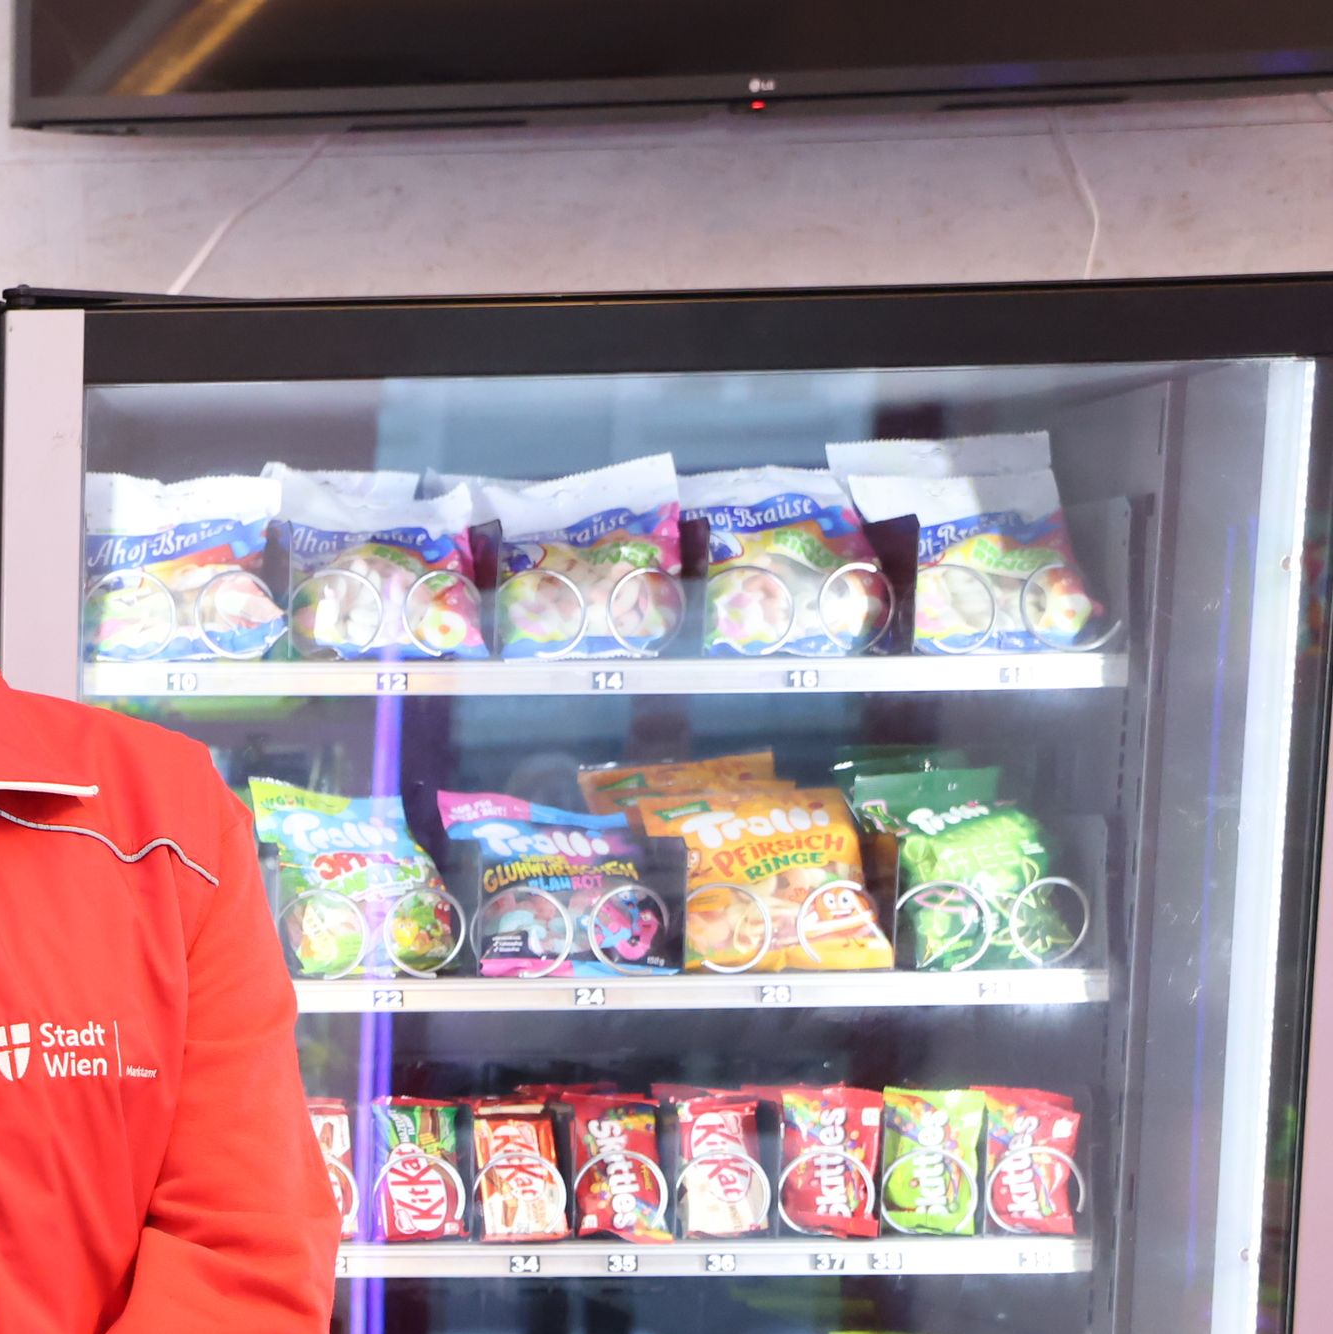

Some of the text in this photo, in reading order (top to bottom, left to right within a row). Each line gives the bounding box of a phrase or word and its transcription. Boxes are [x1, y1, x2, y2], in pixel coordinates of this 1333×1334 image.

[379, 673, 407, 691] 12
[680, 808, 830, 849] Trolli
[906, 803, 991, 836] Trolli
[282, 813, 399, 853] Trolli
[471, 822, 610, 857] Trolli
[572, 873, 604, 891] ROT
[374, 991, 404, 1008] 22
[575, 988, 605, 1006] 24
[39, 1020, 106, 1048] Stadt
[42, 1051, 108, 1078] Wien
[125, 1064, 158, 1079] Marktamt
[389, 1146, 445, 1223] KitKat
[587, 1118, 640, 1230] Skittles
[510, 1256, 540, 1272] 34
[608, 1256, 638, 1272] 35
[705, 1255, 735, 1272] 36
